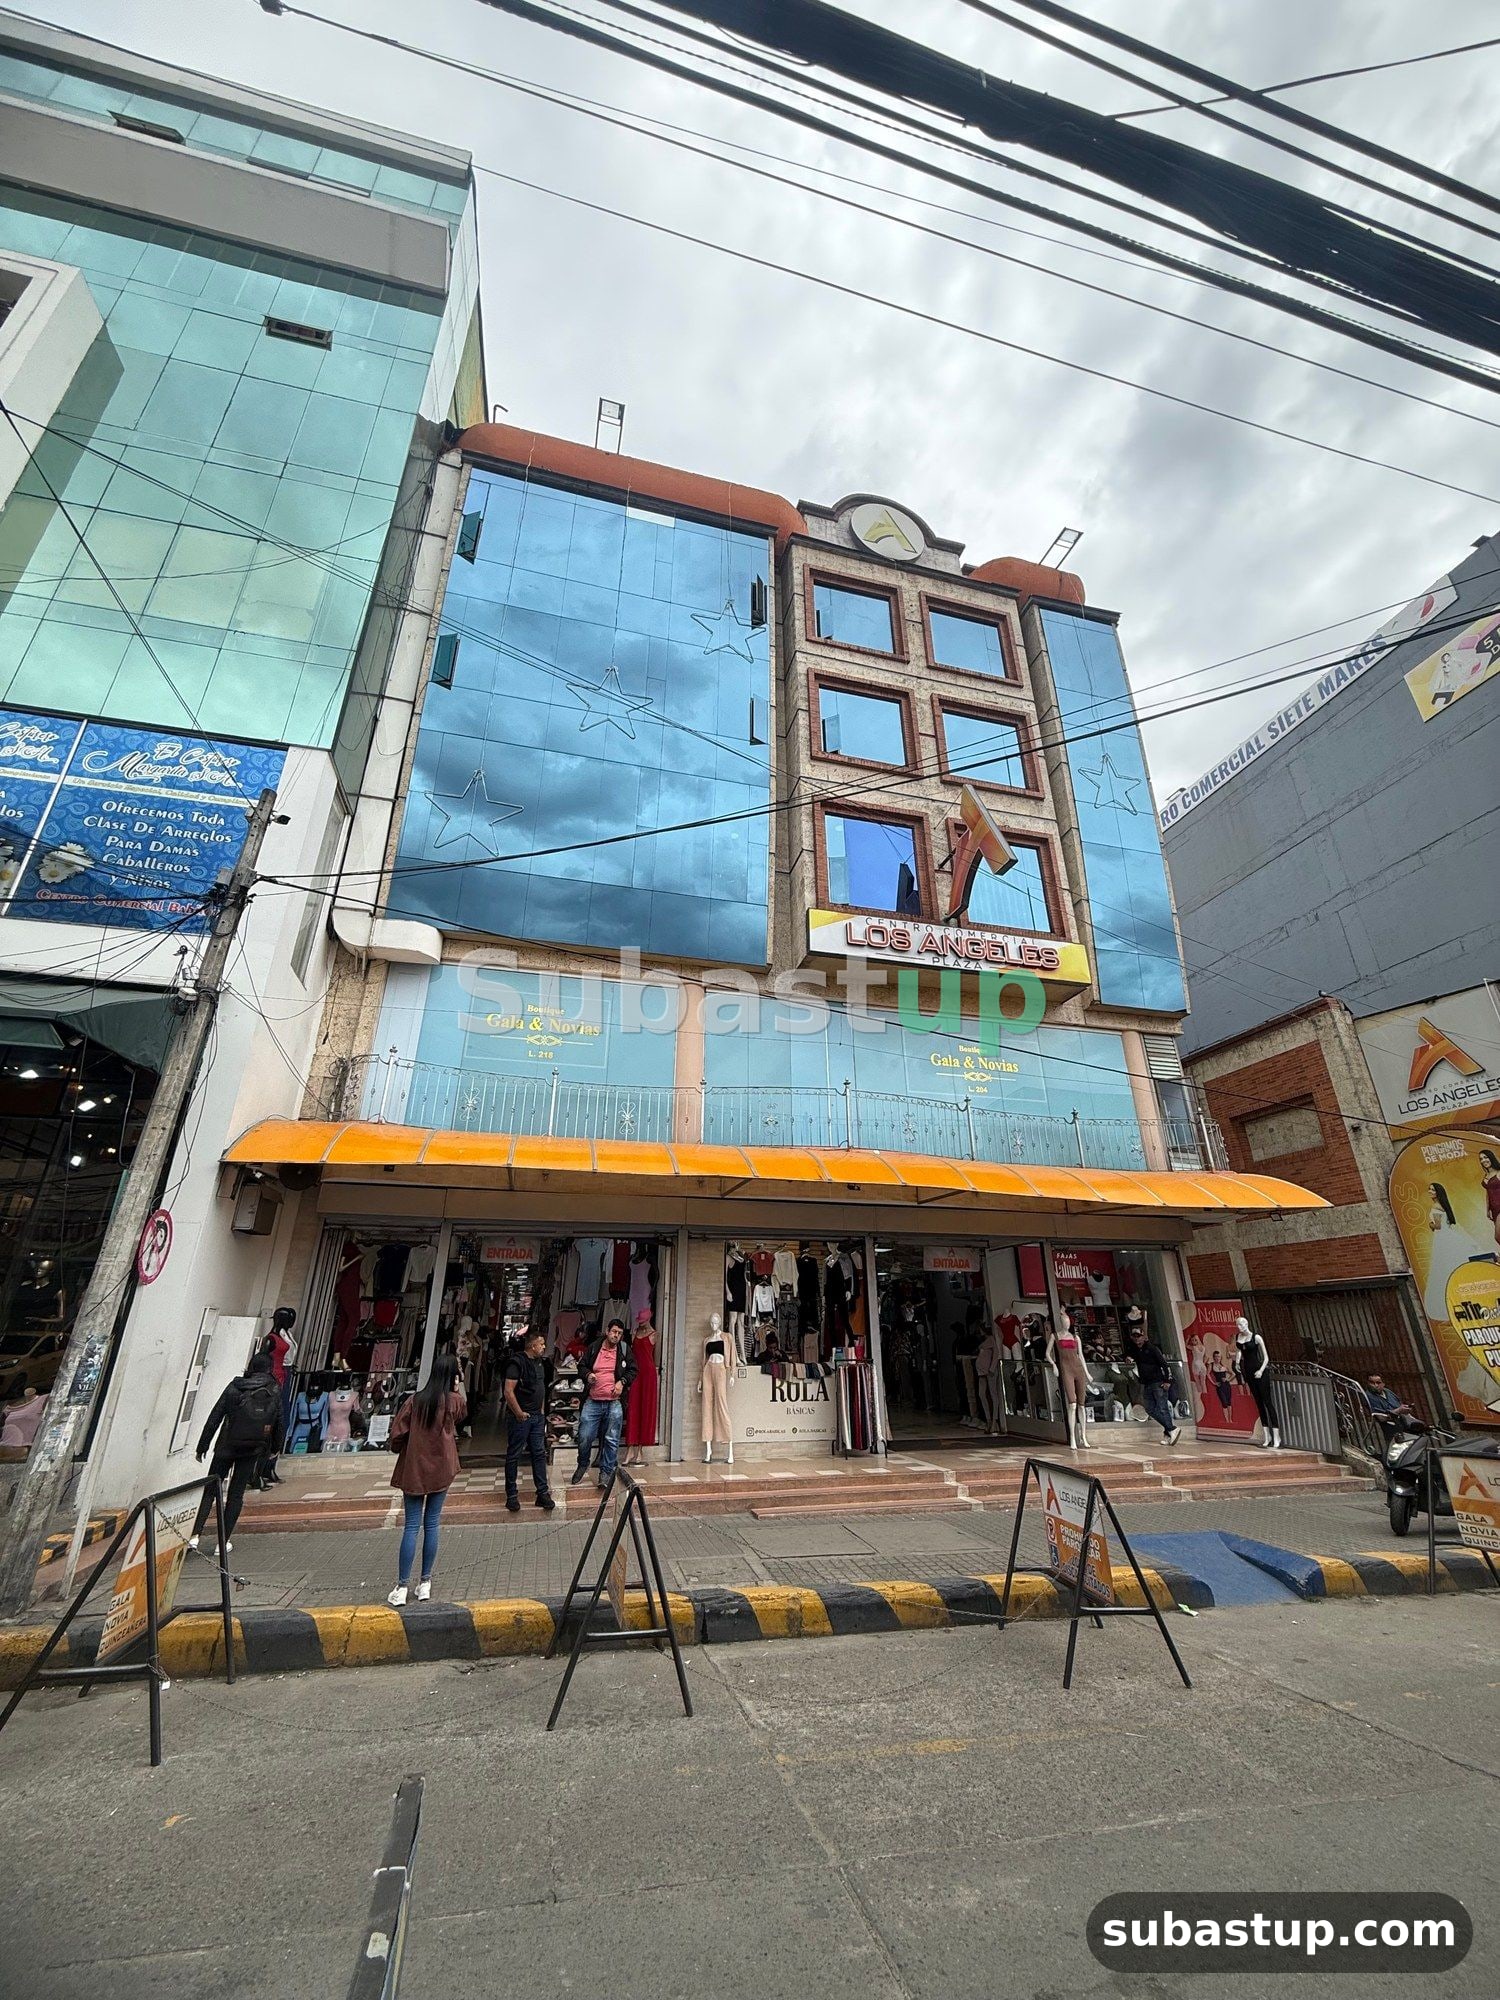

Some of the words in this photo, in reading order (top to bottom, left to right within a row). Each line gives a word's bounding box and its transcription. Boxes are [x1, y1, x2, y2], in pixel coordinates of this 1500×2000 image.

[1181, 735, 1266, 810] COMERCIAL
[1267, 692, 1315, 740] SIETE
[1316, 633, 1388, 701] MARES
[82, 750, 189, 783] Margarita
[865, 917, 934, 933] CENTRO
[943, 927, 1037, 945] COMERCIAL
[845, 921, 913, 951] LOS
[917, 931, 1061, 970] ANGELES
[932, 956, 983, 970] PLAZA
[527, 1004, 565, 1016] Boutique
[486, 1013, 525, 1031] Gala
[529, 1017, 544, 1031] &
[549, 1018, 601, 1036] Novias
[930, 1053, 960, 1068] Gala
[963, 1056, 975, 1069] &
[977, 1057, 1019, 1073] Novias
[1398, 1097, 1430, 1115] LOS
[1440, 1101, 1470, 1112] PLAZA
[1425, 1155, 1438, 1164] DE
[1438, 1150, 1469, 1161] MODA
[486, 1246, 533, 1260] ENTRADA
[933, 1257, 970, 1269] ENTRADA
[770, 1377, 830, 1402] ROLA
[1456, 1513, 1488, 1524] GALA
[1461, 1525, 1499, 1537] NOVIA
[109, 1591, 131, 1612] GALA
[103, 1610, 130, 1633] NOVIA
